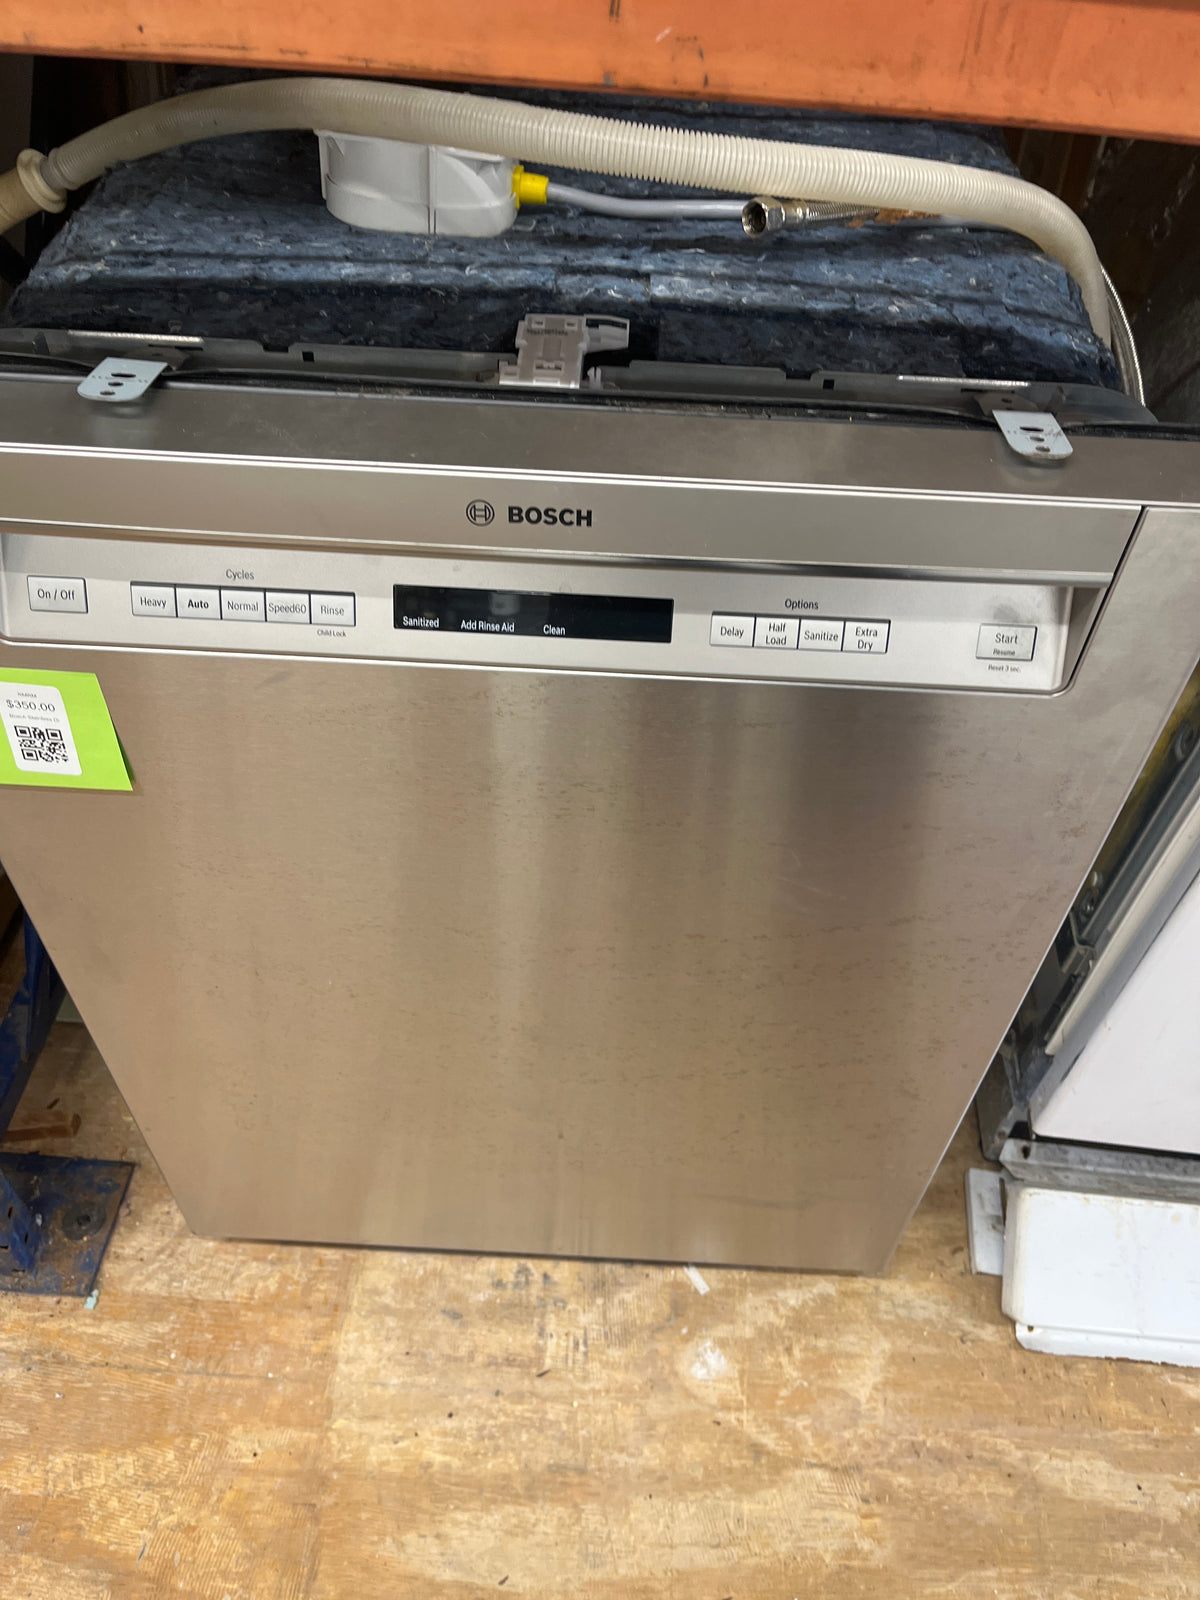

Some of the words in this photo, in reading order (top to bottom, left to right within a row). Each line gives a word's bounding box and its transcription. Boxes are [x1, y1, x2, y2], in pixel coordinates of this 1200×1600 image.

[507, 505, 593, 528] BOSCH
[225, 568, 255, 581] Cycles
[37, 588, 51, 600] On
[53, 588, 58, 601] /
[60, 588, 75, 601] Off
[139, 596, 167, 609] Heavy
[187, 599, 210, 610] Auto
[227, 600, 259, 612] Normal
[268, 602, 307, 615] Speed60
[784, 598, 819, 610] Options
[320, 604, 345, 616] Rinse
[402, 615, 440, 628] Sanitized
[460, 619, 477, 631] Add
[478, 621, 500, 632] Rinse
[501, 622, 515, 633] Aid
[768, 622, 787, 633] Half
[316, 629, 332, 637] Child
[332, 630, 347, 638] Lock
[543, 624, 566, 636] Clean
[720, 626, 744, 638] Delay
[803, 630, 839, 642] Sanitize
[855, 626, 878, 637] Extra
[765, 635, 787, 646] Load
[995, 632, 1018, 645] Start
[857, 639, 874, 652] Dry
[5, 698, 56, 712] $350.00
